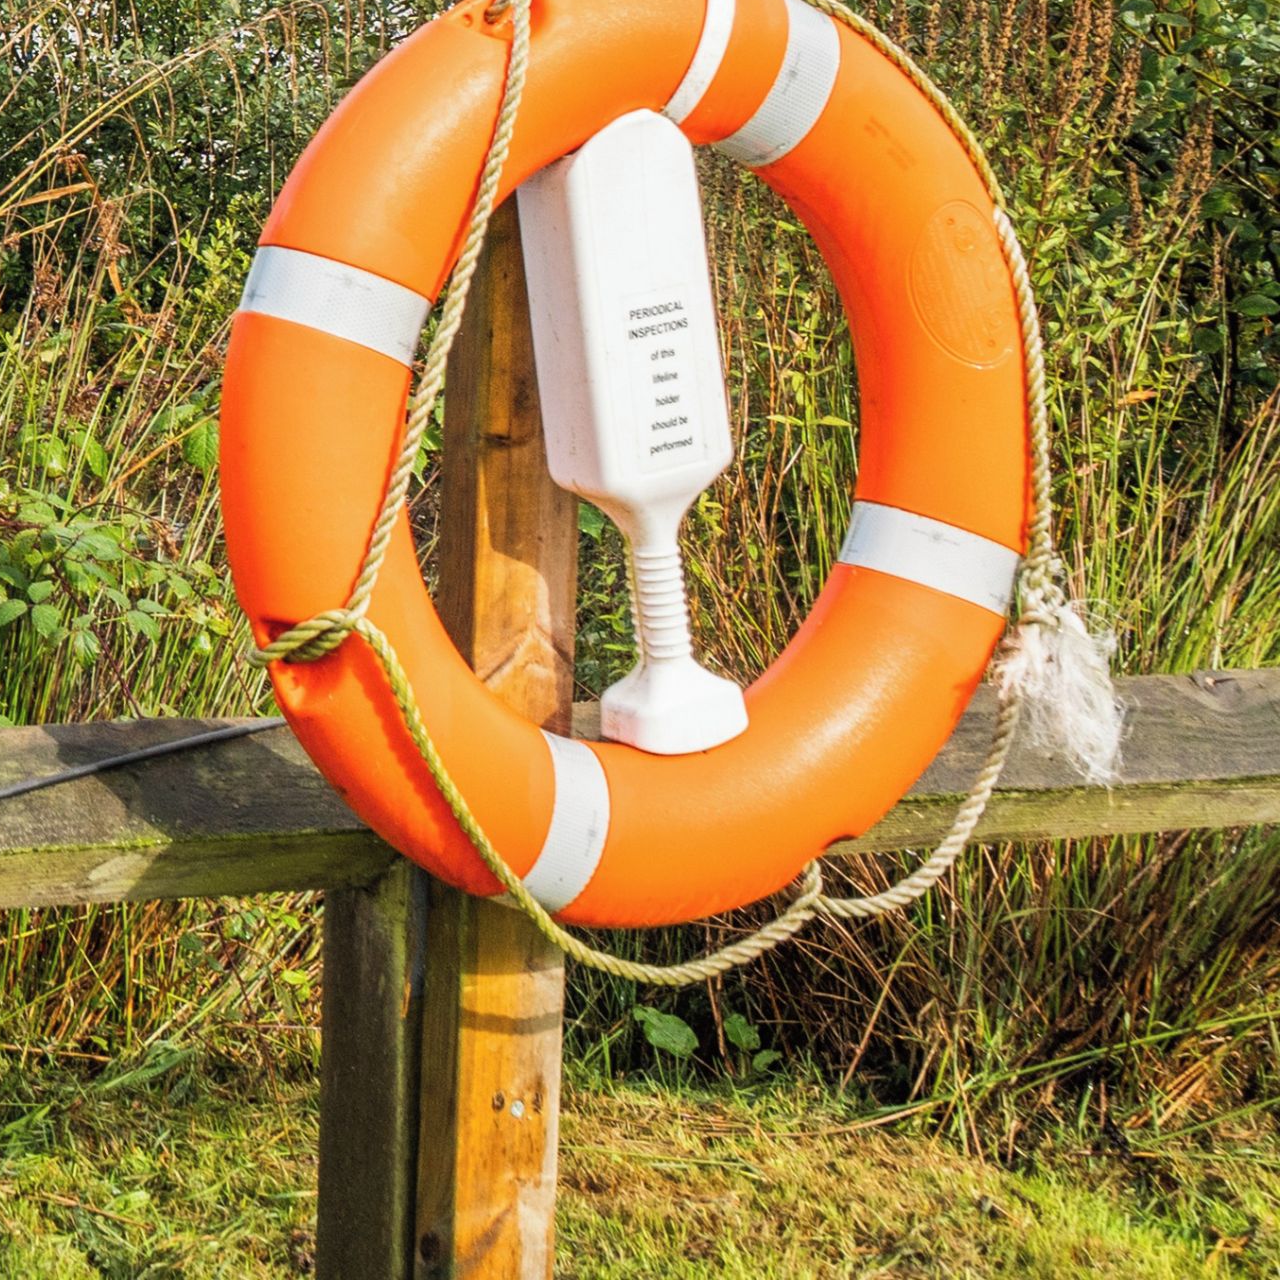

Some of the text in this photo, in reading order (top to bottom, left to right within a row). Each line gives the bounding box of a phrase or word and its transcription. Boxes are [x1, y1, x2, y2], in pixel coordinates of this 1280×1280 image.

[629, 300, 684, 320] PERIODICAL
[628, 317, 689, 340] INSPECTIONS
[650, 348, 675, 361] of this
[652, 371, 678, 384] lifeline
[655, 394, 680, 407] holder
[650, 415, 688, 431] should be
[650, 436, 693, 456] performed
